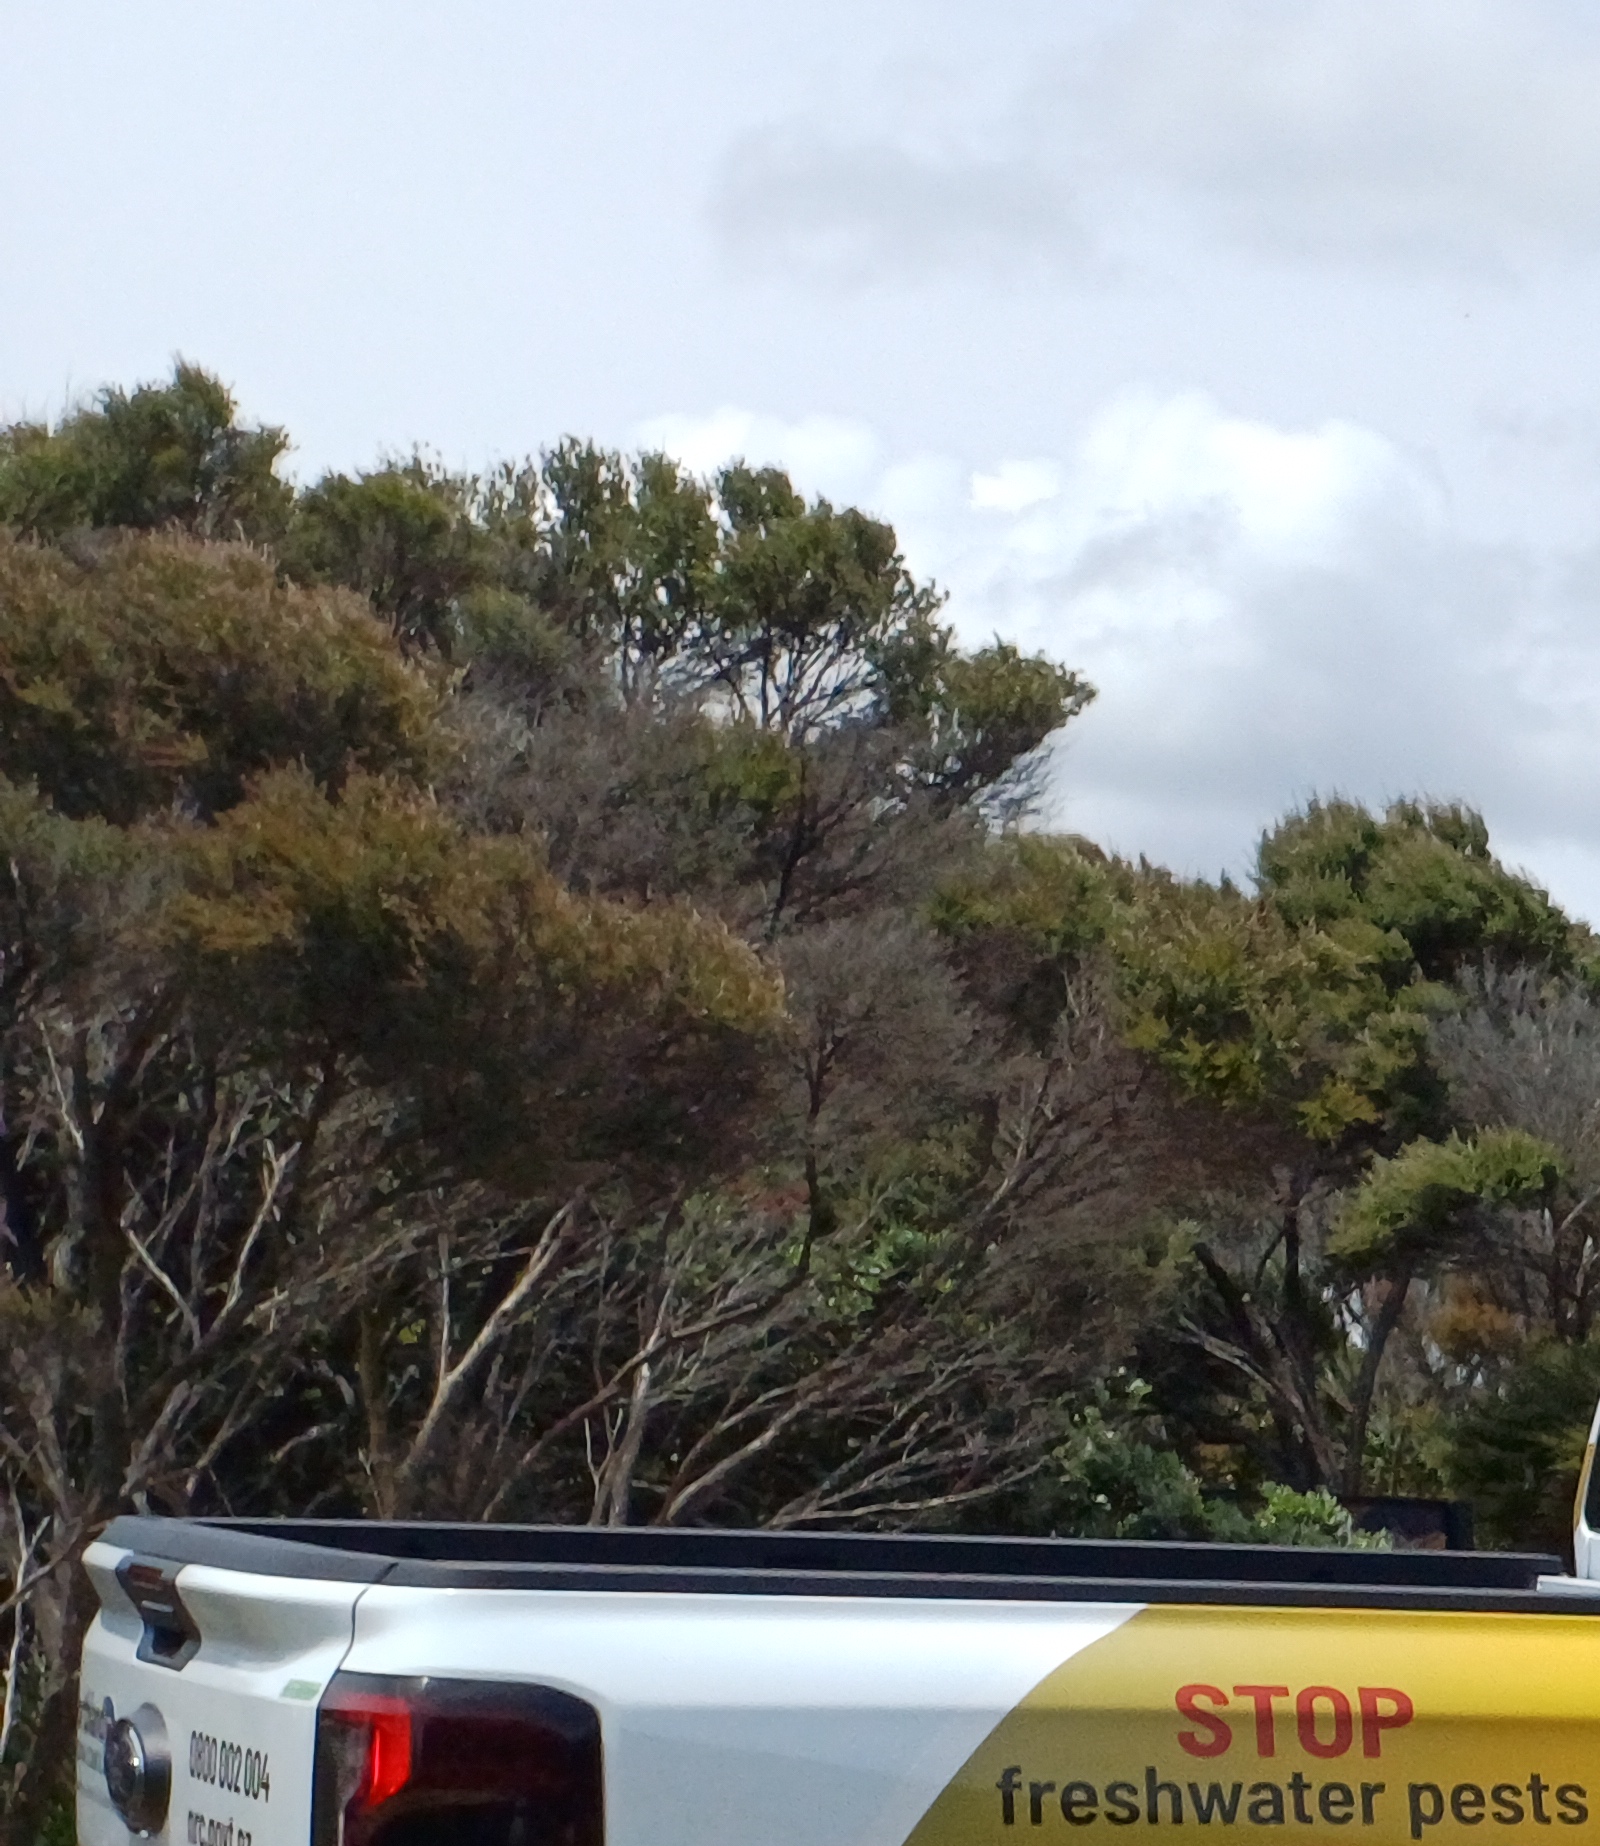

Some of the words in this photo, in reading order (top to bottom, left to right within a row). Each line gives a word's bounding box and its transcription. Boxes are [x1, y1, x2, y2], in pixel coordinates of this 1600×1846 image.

[1175, 1682, 1416, 1760] STOP
[189, 1730, 217, 1785] 0800
[219, 1740, 242, 1794] 002
[243, 1748, 270, 1803] 004
[996, 1765, 1386, 1828] freshwater
[1408, 1772, 1590, 1838] pests
